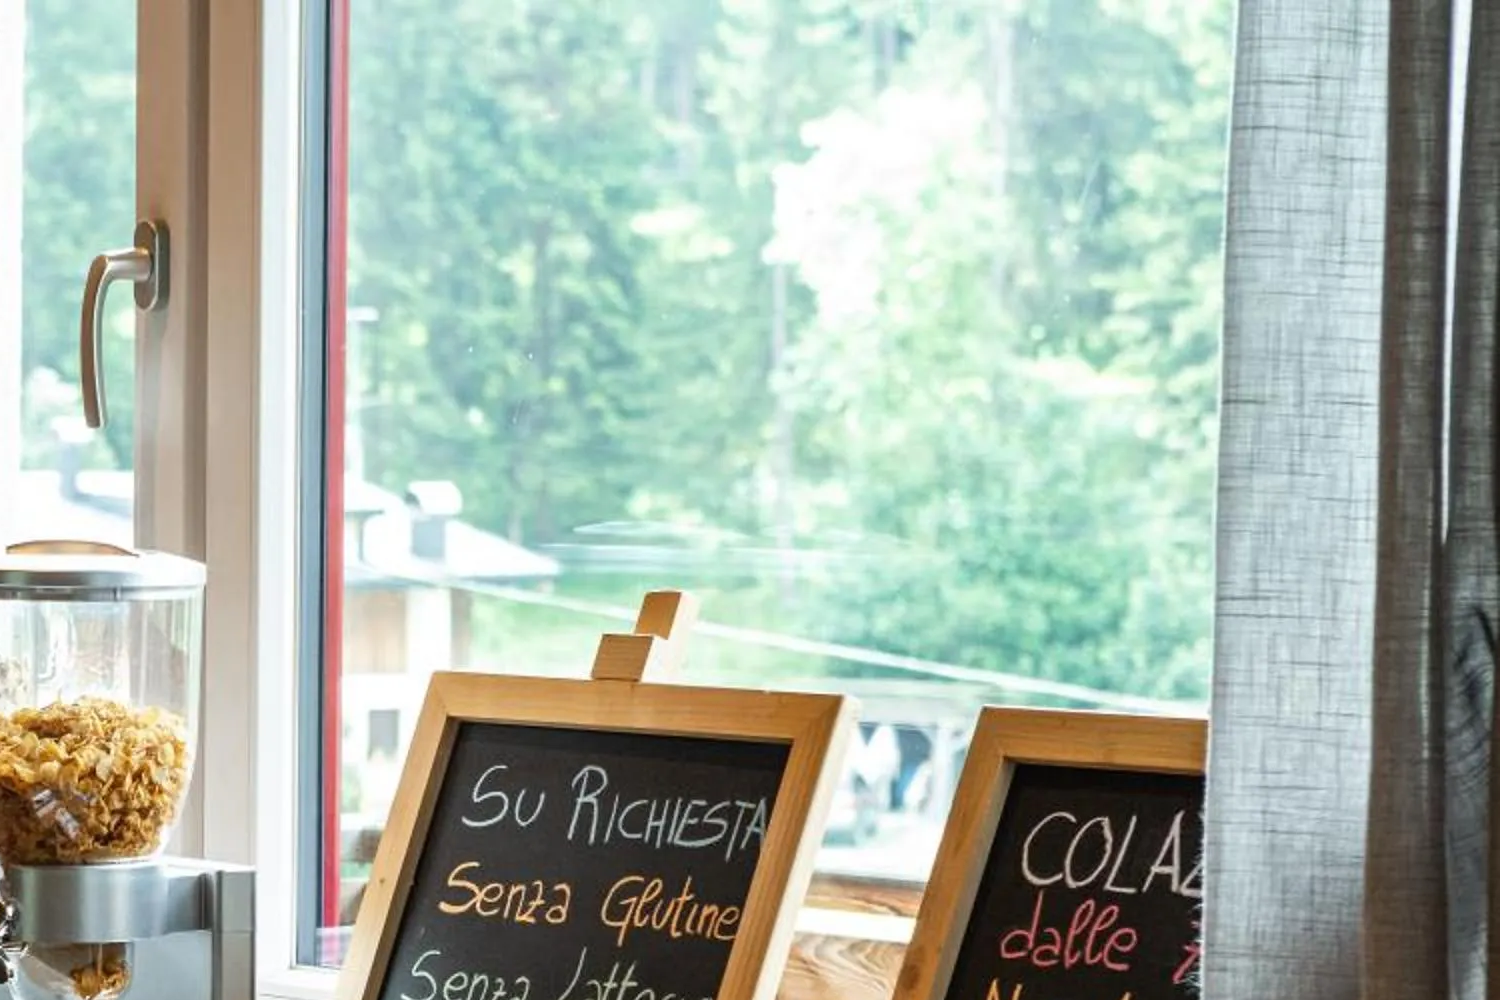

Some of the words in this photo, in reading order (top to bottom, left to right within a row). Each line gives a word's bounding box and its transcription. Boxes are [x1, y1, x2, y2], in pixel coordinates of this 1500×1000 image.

[438, 861, 572, 924] Senza
[601, 874, 741, 947] Glutine
[1001, 889, 1138, 971] dalle
